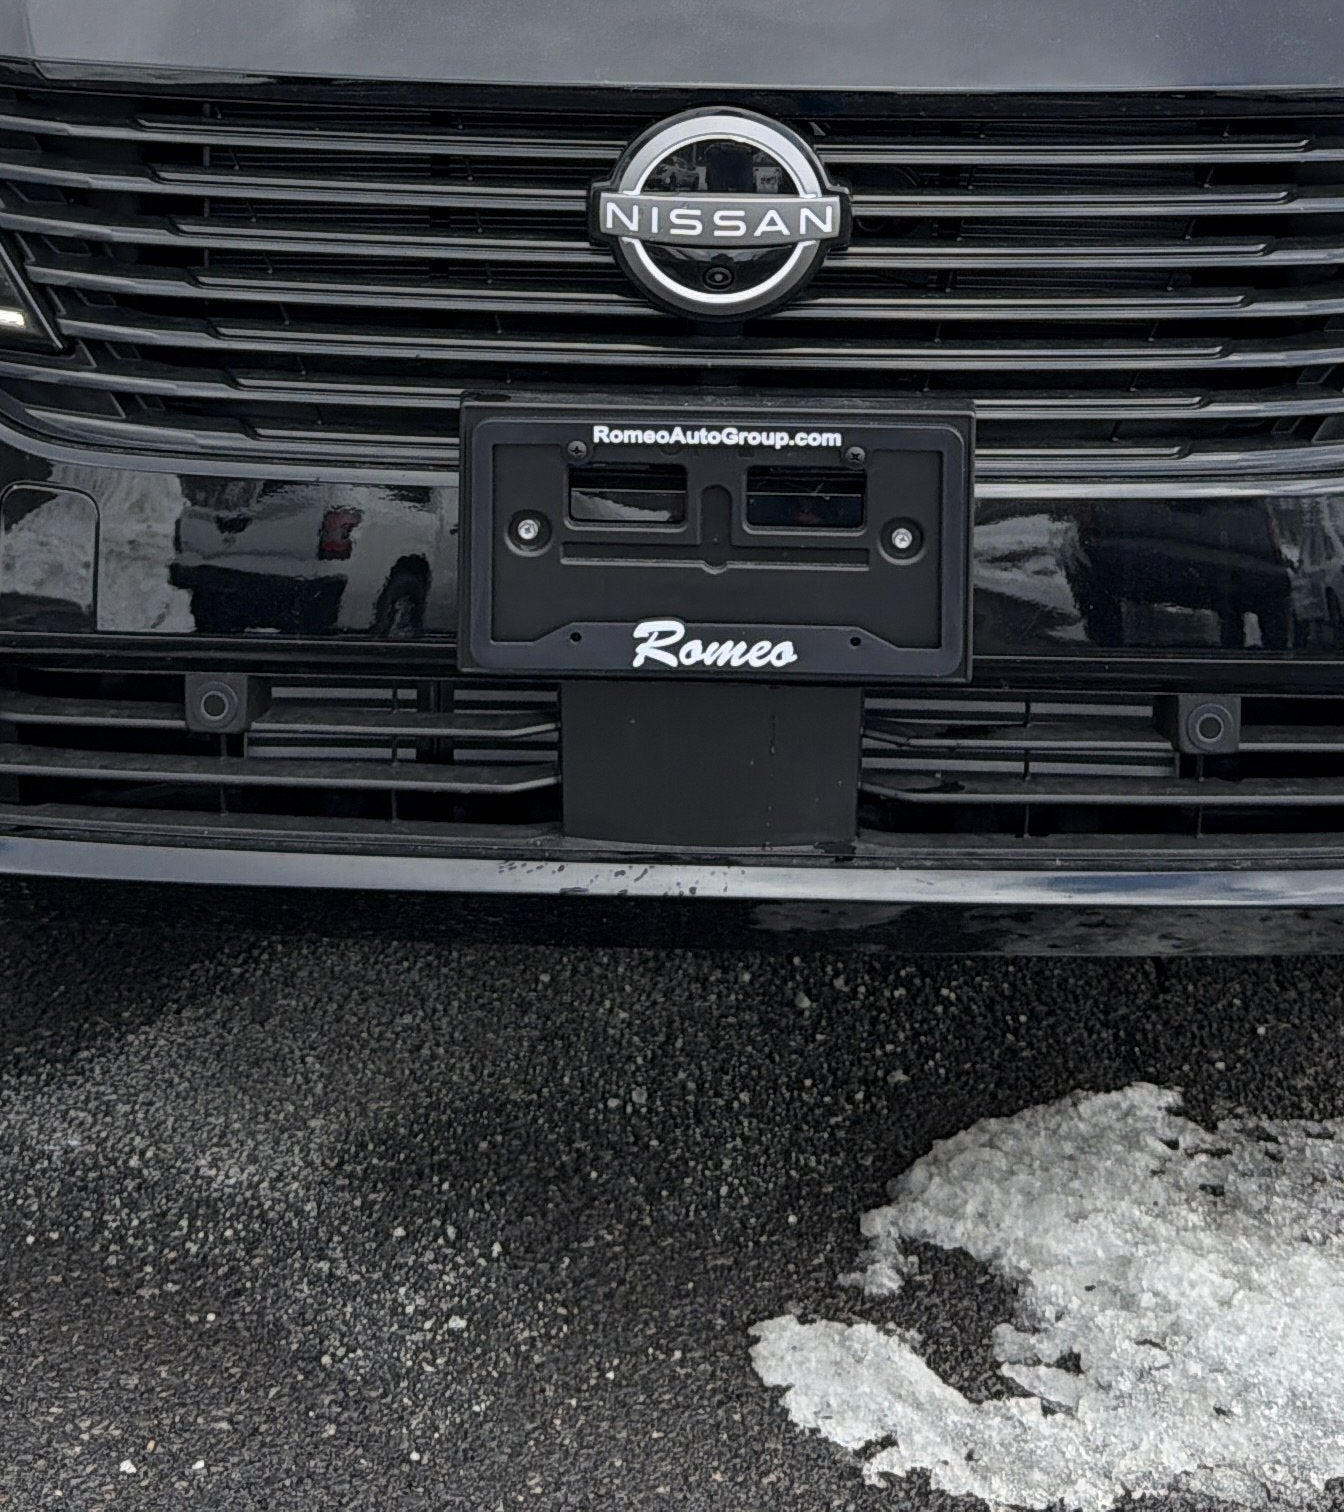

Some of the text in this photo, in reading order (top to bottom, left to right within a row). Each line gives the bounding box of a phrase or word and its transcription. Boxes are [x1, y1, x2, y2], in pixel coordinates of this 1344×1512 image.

[606, 202, 833, 237] NISSAN
[592, 425, 842, 449] RomeoAutoGroup.com
[632, 620, 798, 668] Romeo
